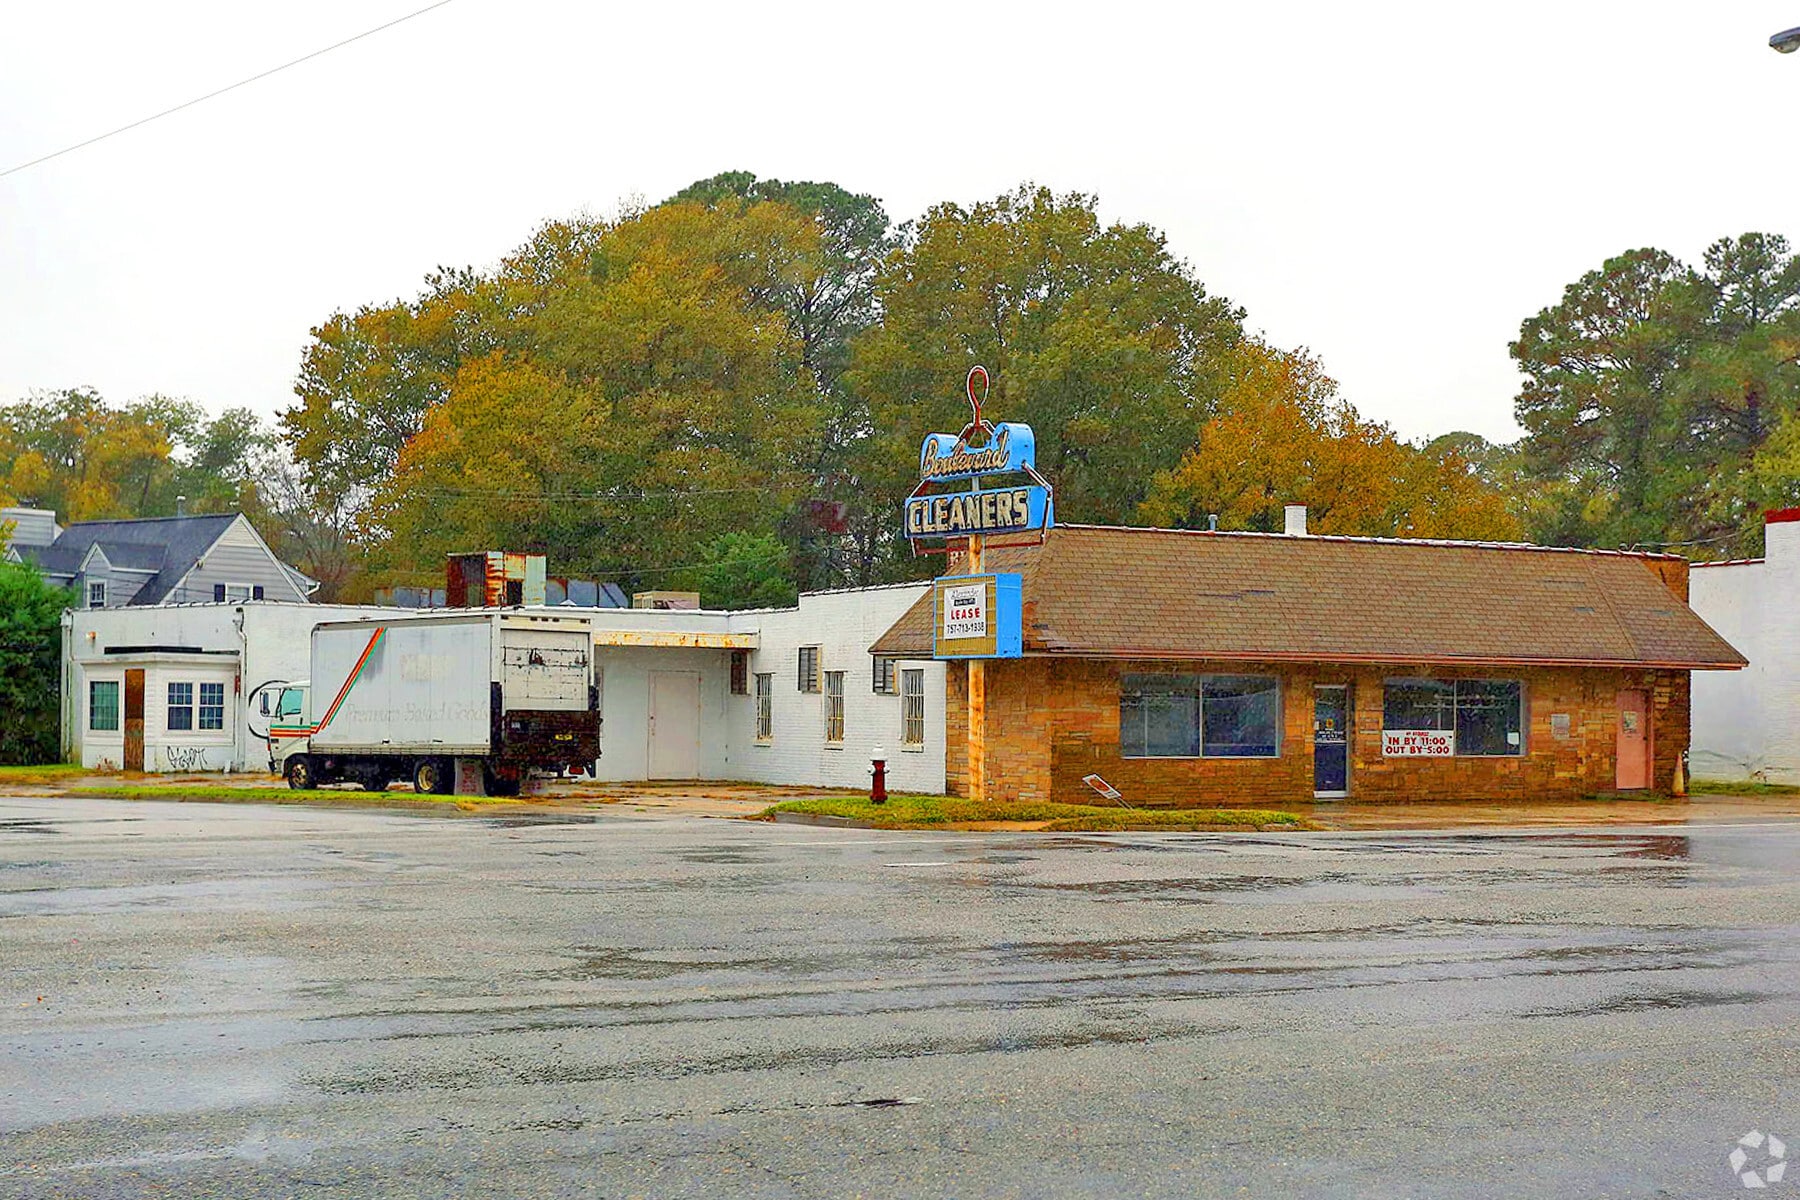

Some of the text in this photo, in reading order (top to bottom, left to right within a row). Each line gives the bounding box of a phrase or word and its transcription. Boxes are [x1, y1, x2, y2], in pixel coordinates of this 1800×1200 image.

[922, 429, 1009, 477] Boulevard
[907, 489, 1028, 534] CLEANERS
[950, 607, 980, 620] LEASE
[1388, 737, 1446, 745] IN BY 11:00
[1385, 746, 1450, 754] OUT BY 5:00
